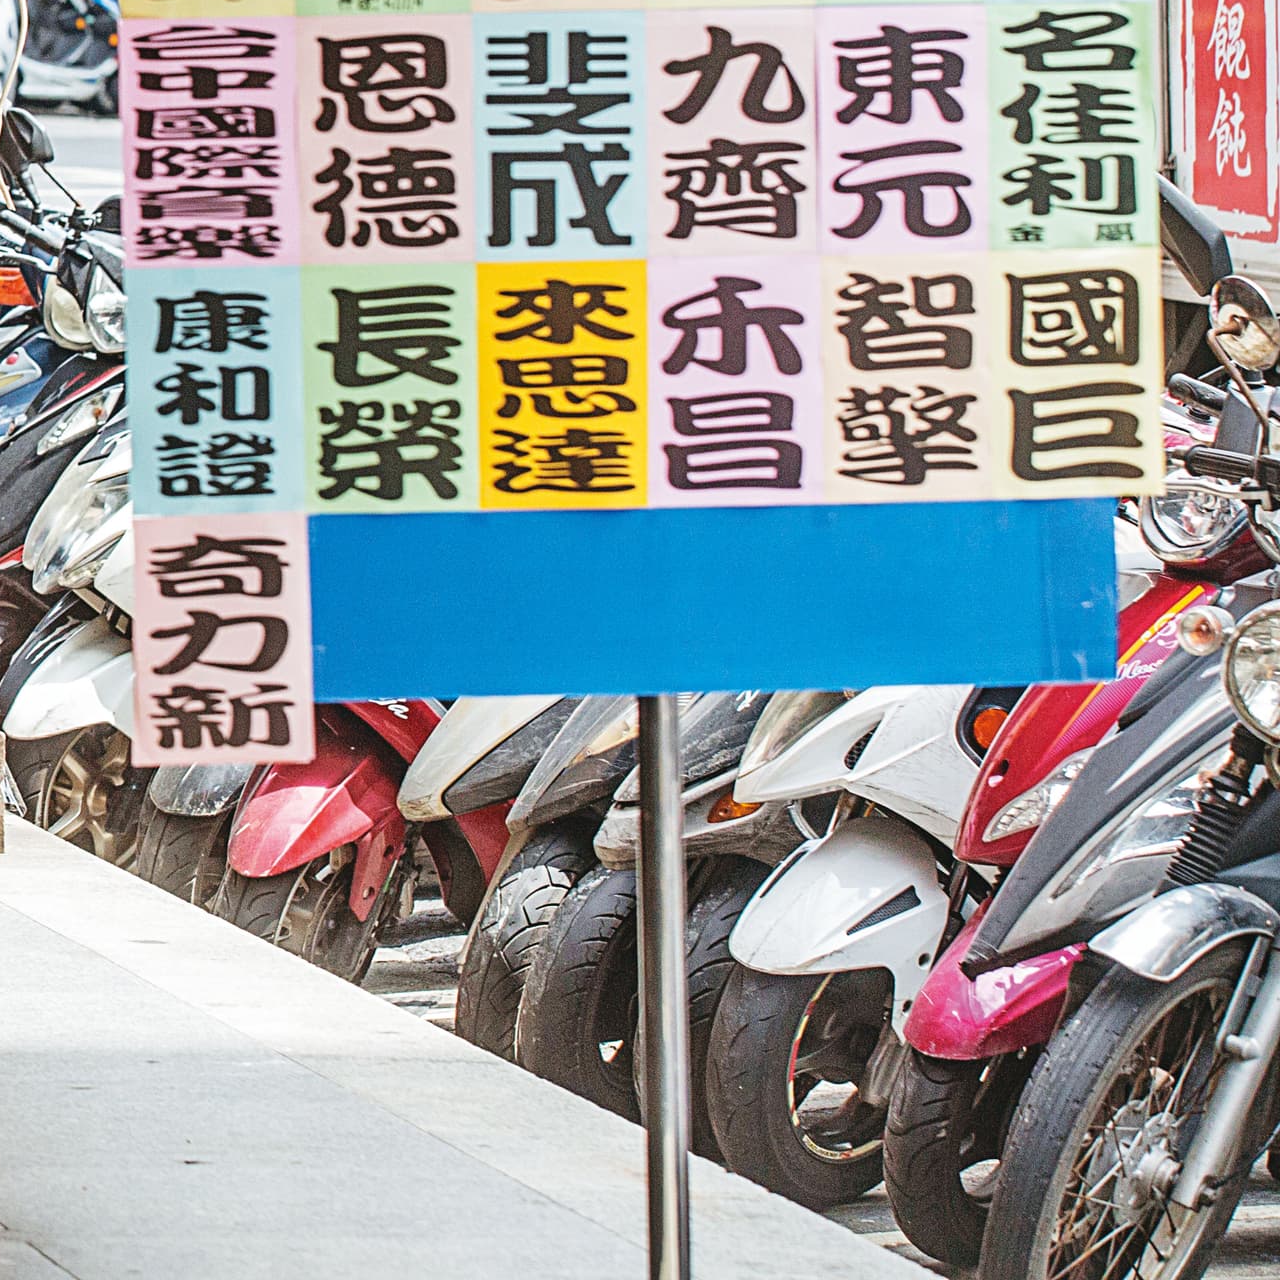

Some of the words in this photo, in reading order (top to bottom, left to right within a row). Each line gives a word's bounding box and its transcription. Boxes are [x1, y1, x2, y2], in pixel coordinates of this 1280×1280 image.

[312, 33, 460, 248] 恩德
[485, 31, 632, 248] 斐成
[663, 26, 807, 240] 九齊
[831, 25, 972, 239] 東元
[1001, 11, 1140, 216] 名佳利
[154, 290, 276, 498] 康和證
[316, 285, 463, 501] 長榮
[492, 279, 637, 494] 來思達
[662, 276, 805, 490] 禾昌
[836, 273, 978, 486] 智擎
[1005, 269, 1145, 482] 國巨
[149, 535, 295, 749] 奇力新
